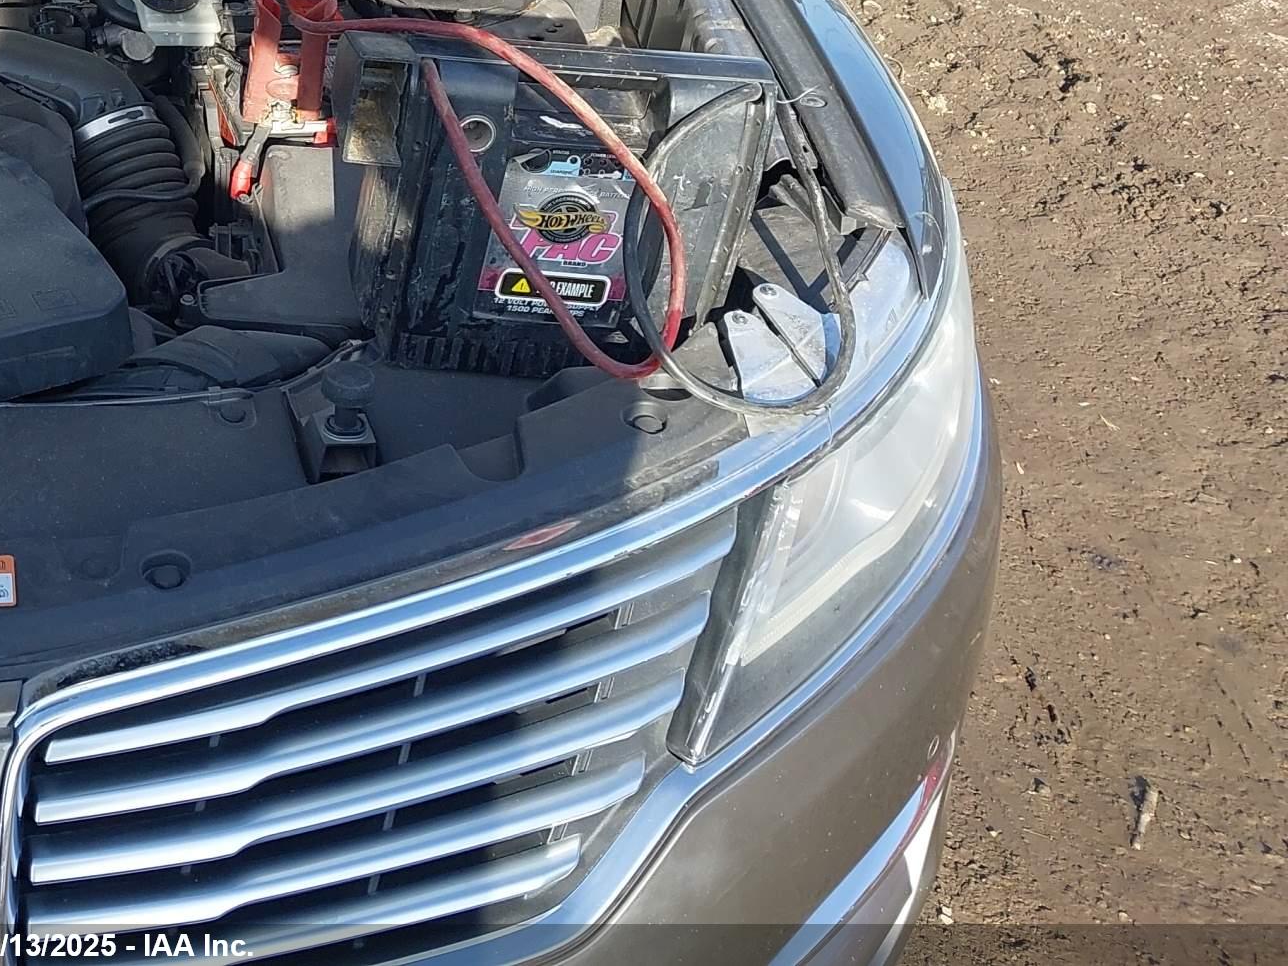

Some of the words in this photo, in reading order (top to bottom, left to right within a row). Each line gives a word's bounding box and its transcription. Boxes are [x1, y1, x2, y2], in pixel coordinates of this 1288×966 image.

[555, 281, 596, 299] EXAMPLE
[506, 297, 529, 305] VOLT
[506, 305, 530, 313] 1500
